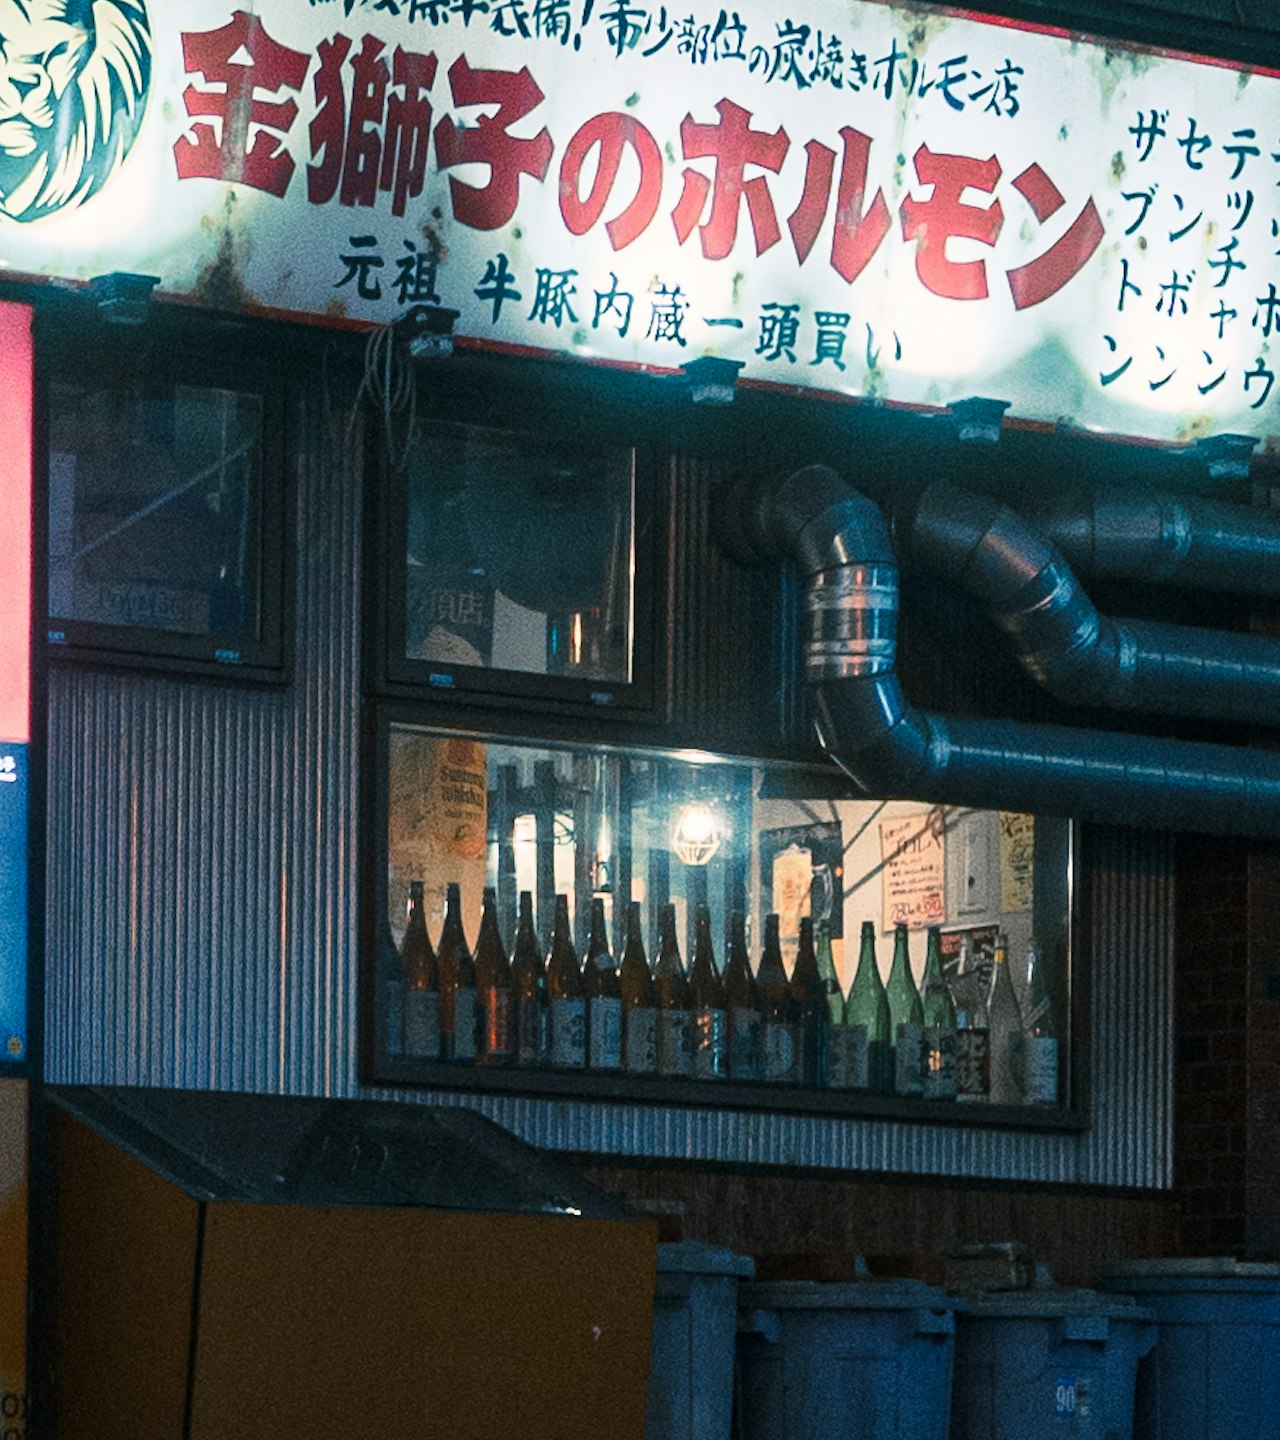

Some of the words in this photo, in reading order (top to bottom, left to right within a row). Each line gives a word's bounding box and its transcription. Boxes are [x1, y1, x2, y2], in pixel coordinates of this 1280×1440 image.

[173, 11, 1105, 310] 金獅子のホルモン
[335, 236, 441, 305] 元祖
[473, 253, 901, 372] 牛豚内蔵一頭買い
